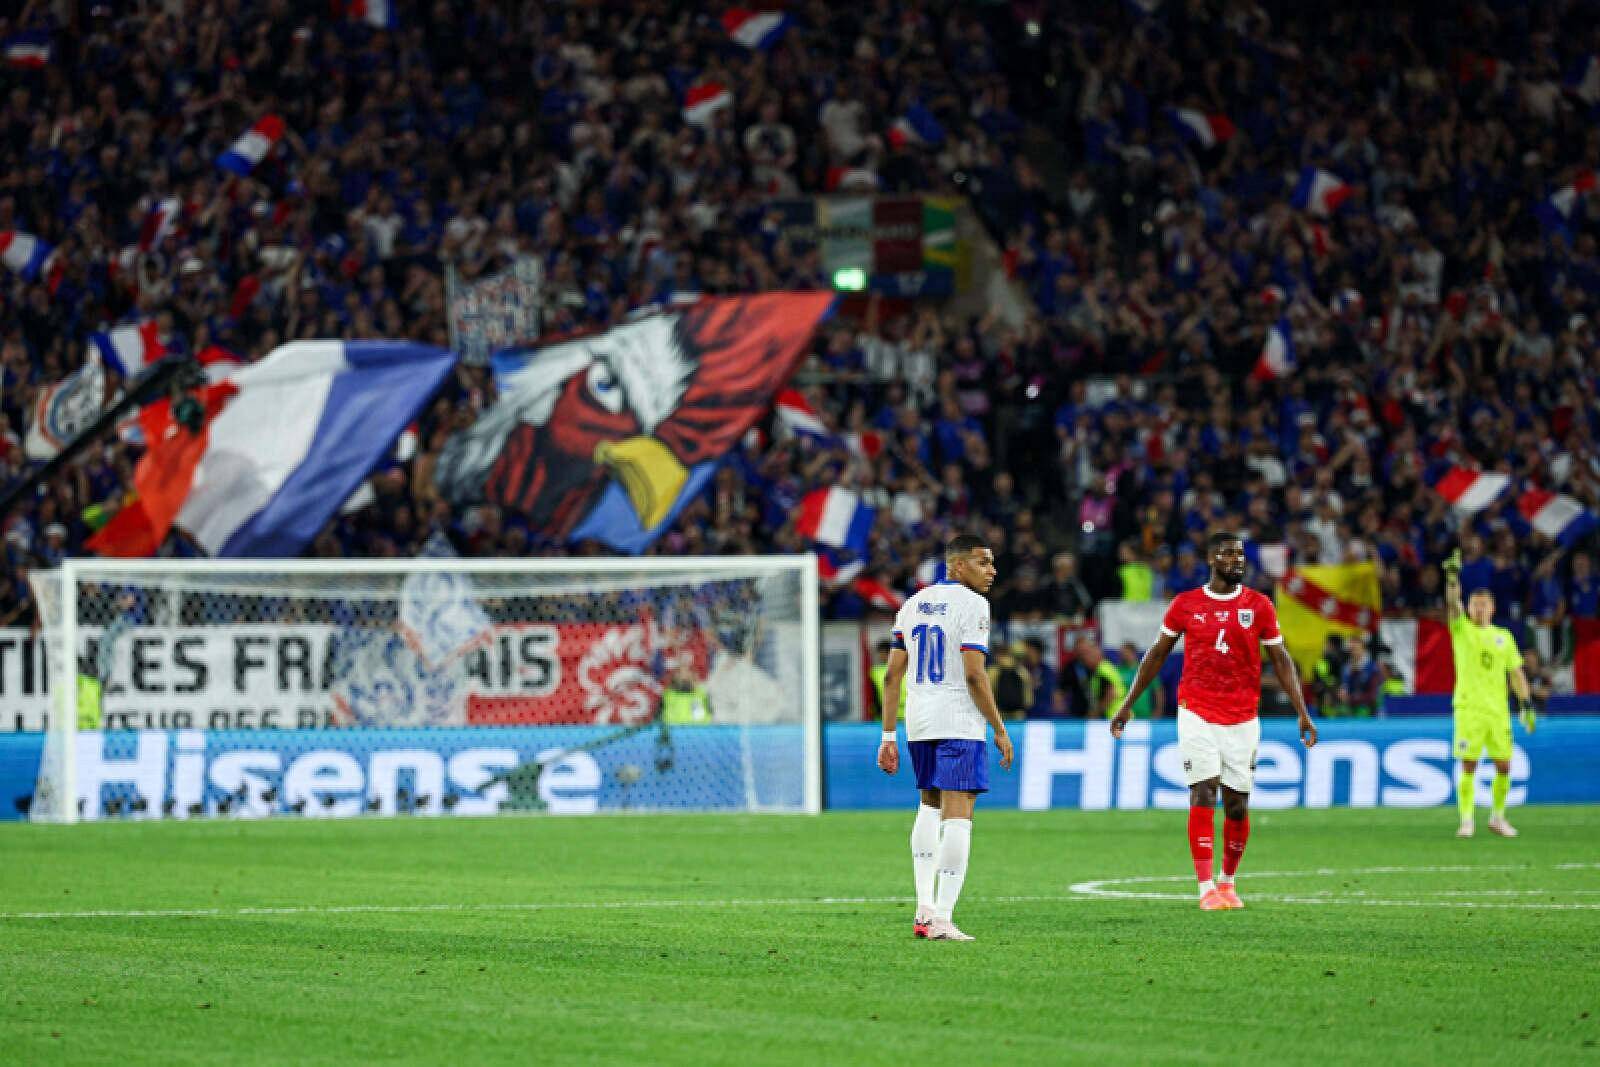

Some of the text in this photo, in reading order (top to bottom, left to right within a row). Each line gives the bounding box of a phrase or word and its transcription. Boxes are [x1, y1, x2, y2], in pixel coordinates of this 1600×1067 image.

[912, 623, 945, 685] 10
[1215, 628, 1231, 654] 4
[76, 731, 600, 818] Hisense
[1019, 720, 1530, 810] Hisense
